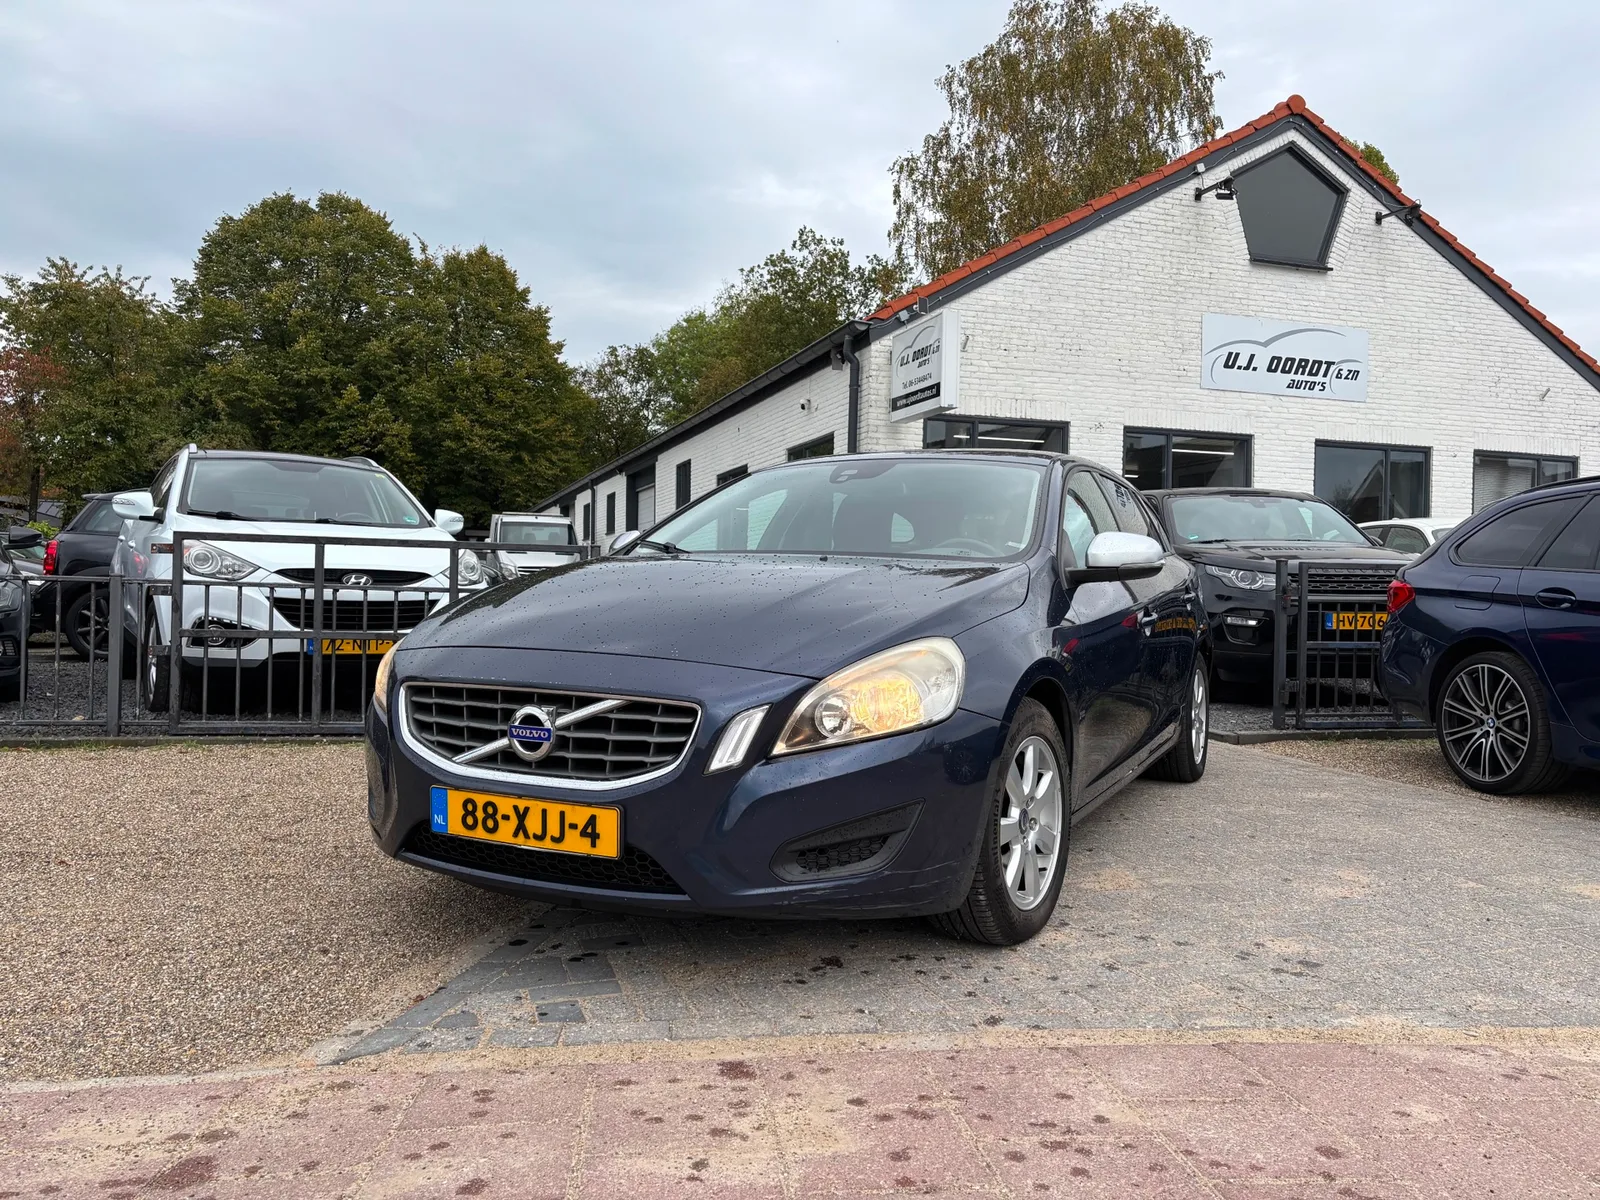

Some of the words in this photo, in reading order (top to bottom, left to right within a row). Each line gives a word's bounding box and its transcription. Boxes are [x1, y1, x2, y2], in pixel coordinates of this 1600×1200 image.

[912, 343, 932, 362] OORDT
[1223, 351, 1258, 372] U.J.
[1266, 355, 1336, 378] OORDT
[1335, 368, 1343, 379] &
[1338, 615, 1385, 628] HV-706
[511, 728, 549, 738] VOLVO
[434, 814, 446, 825] NL
[461, 798, 601, 849] 88-XJJ-4
